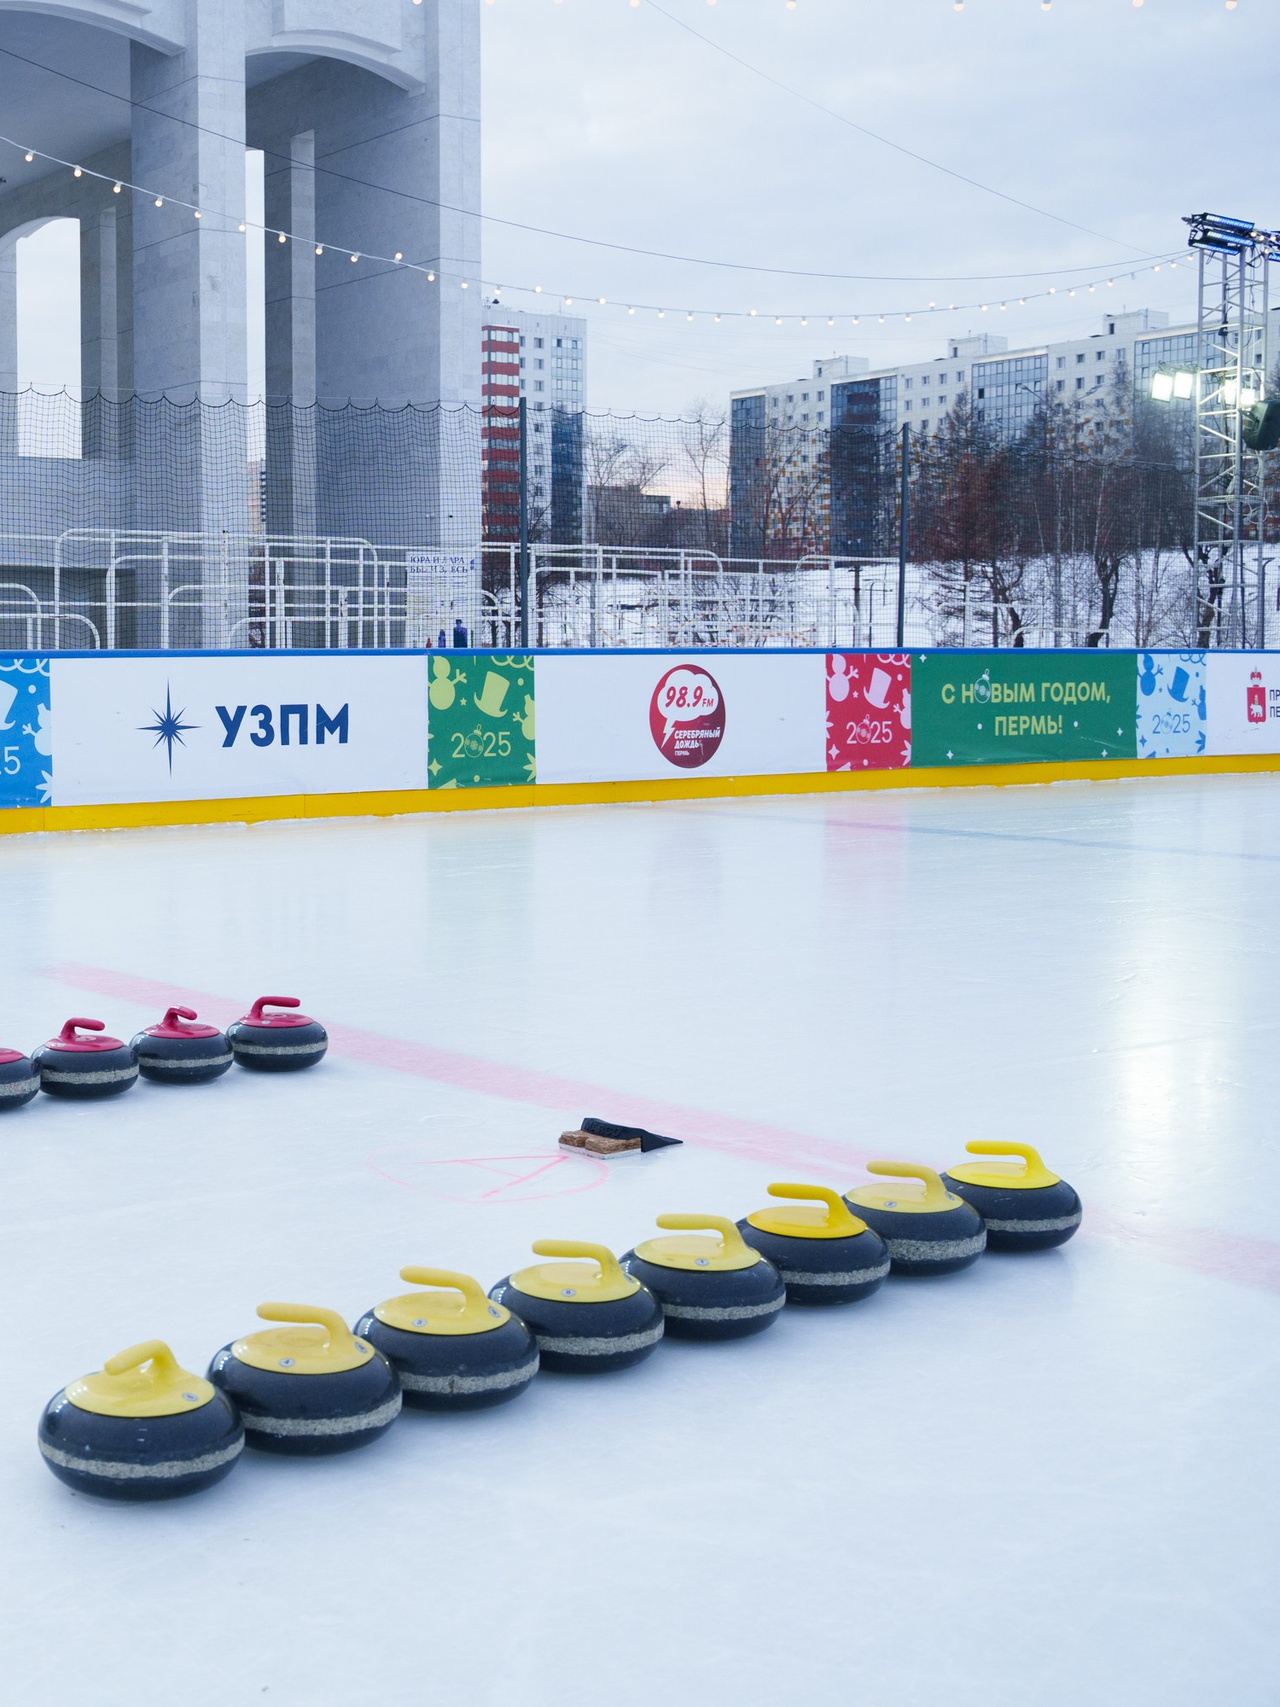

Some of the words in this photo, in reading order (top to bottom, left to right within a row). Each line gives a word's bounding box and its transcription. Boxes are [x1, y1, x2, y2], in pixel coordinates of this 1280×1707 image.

[665, 685, 703, 708] 98.9
[701, 698, 714, 708] FM
[941, 683, 956, 705] С
[1041, 681, 1111, 706] ГОДОМ,
[214, 702, 350, 749] УЗПМ
[674, 726, 721, 740] СЕРЕБРЯНЫЙ
[994, 714, 1064, 737] ПЕРМЬ!
[674, 740, 700, 750] ДОЖДЬ
